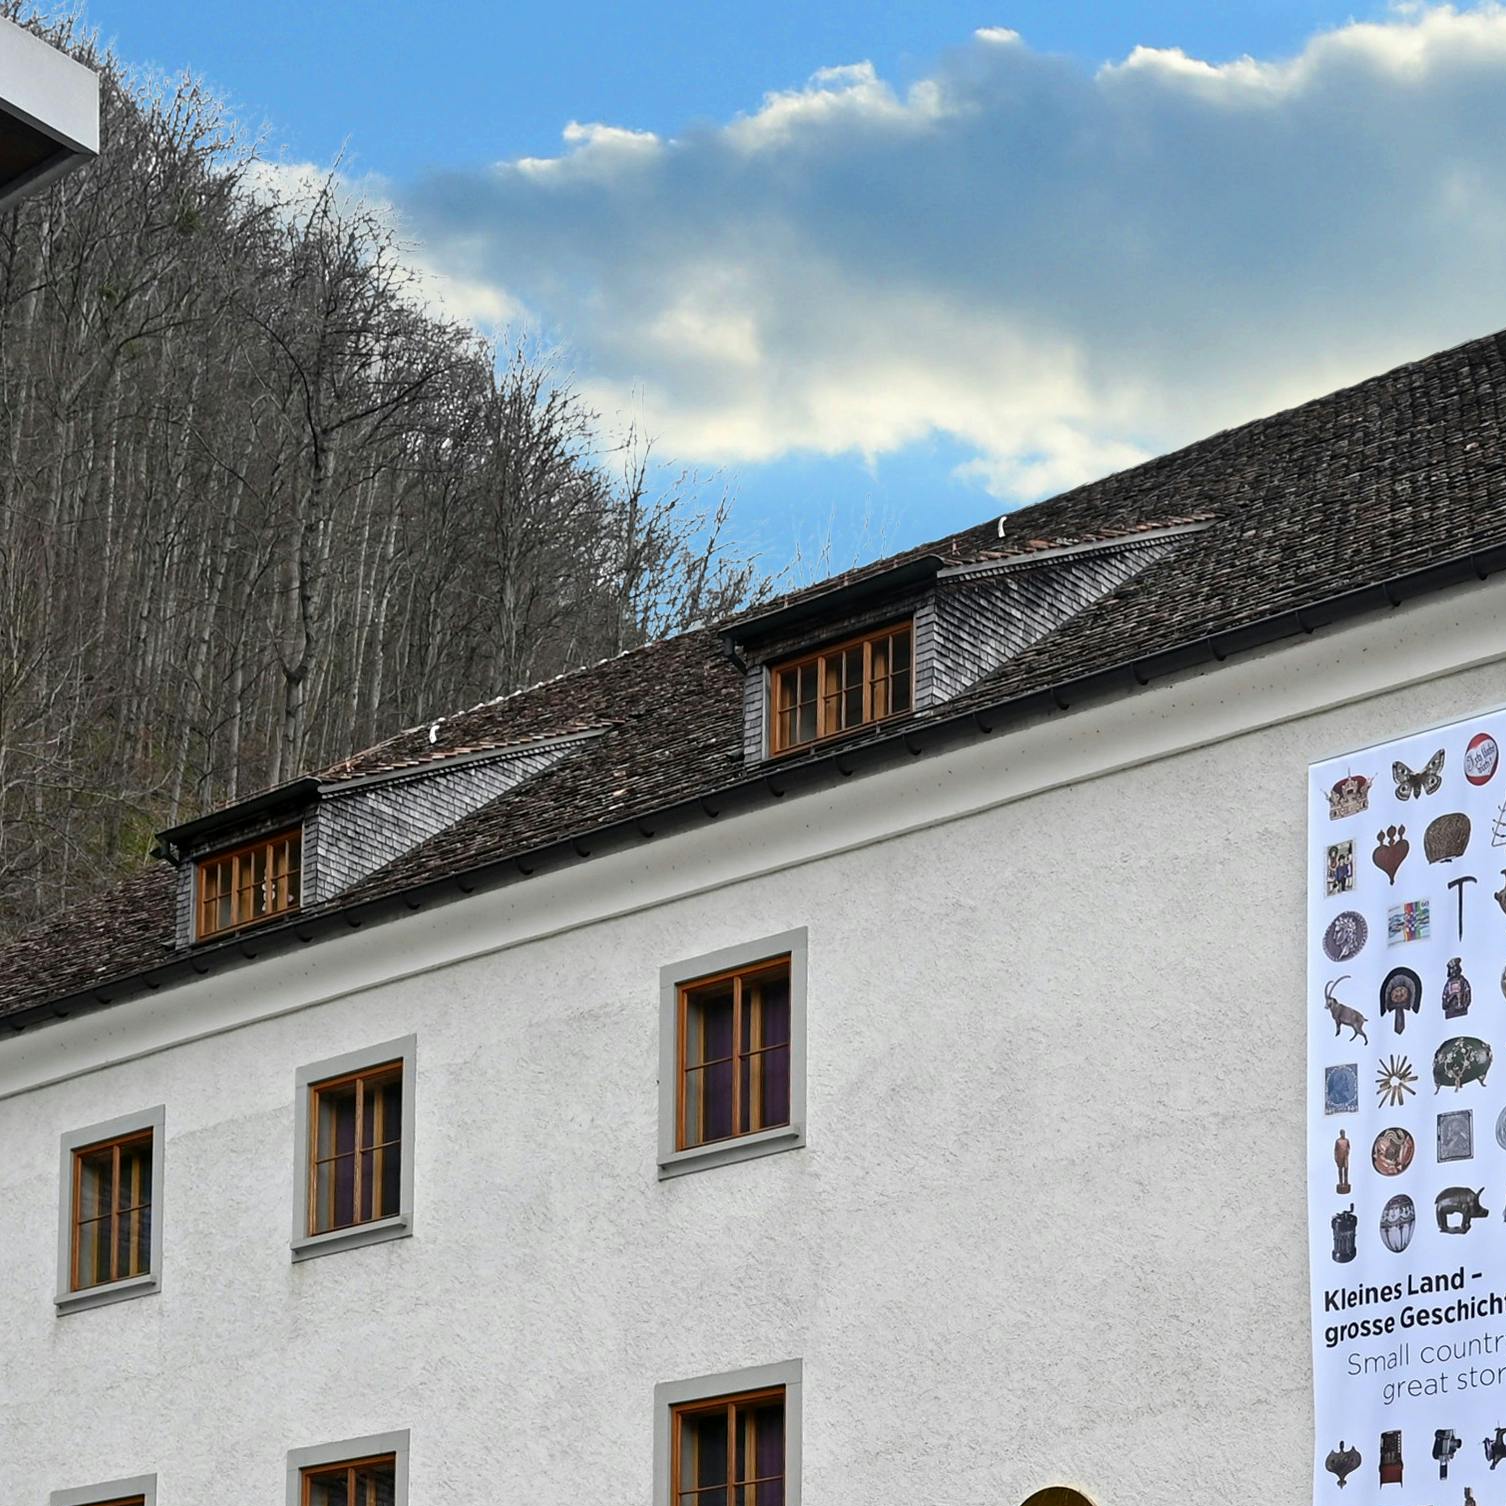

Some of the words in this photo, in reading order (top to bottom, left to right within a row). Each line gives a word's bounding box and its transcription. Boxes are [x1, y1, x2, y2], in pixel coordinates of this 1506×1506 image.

[1325, 1281, 1402, 1312] Kleines
[1407, 1266, 1465, 1296] Land
[1325, 1315, 1396, 1348] grosse
[1347, 1342, 1409, 1375] Small
[1383, 1372, 1449, 1405] great
